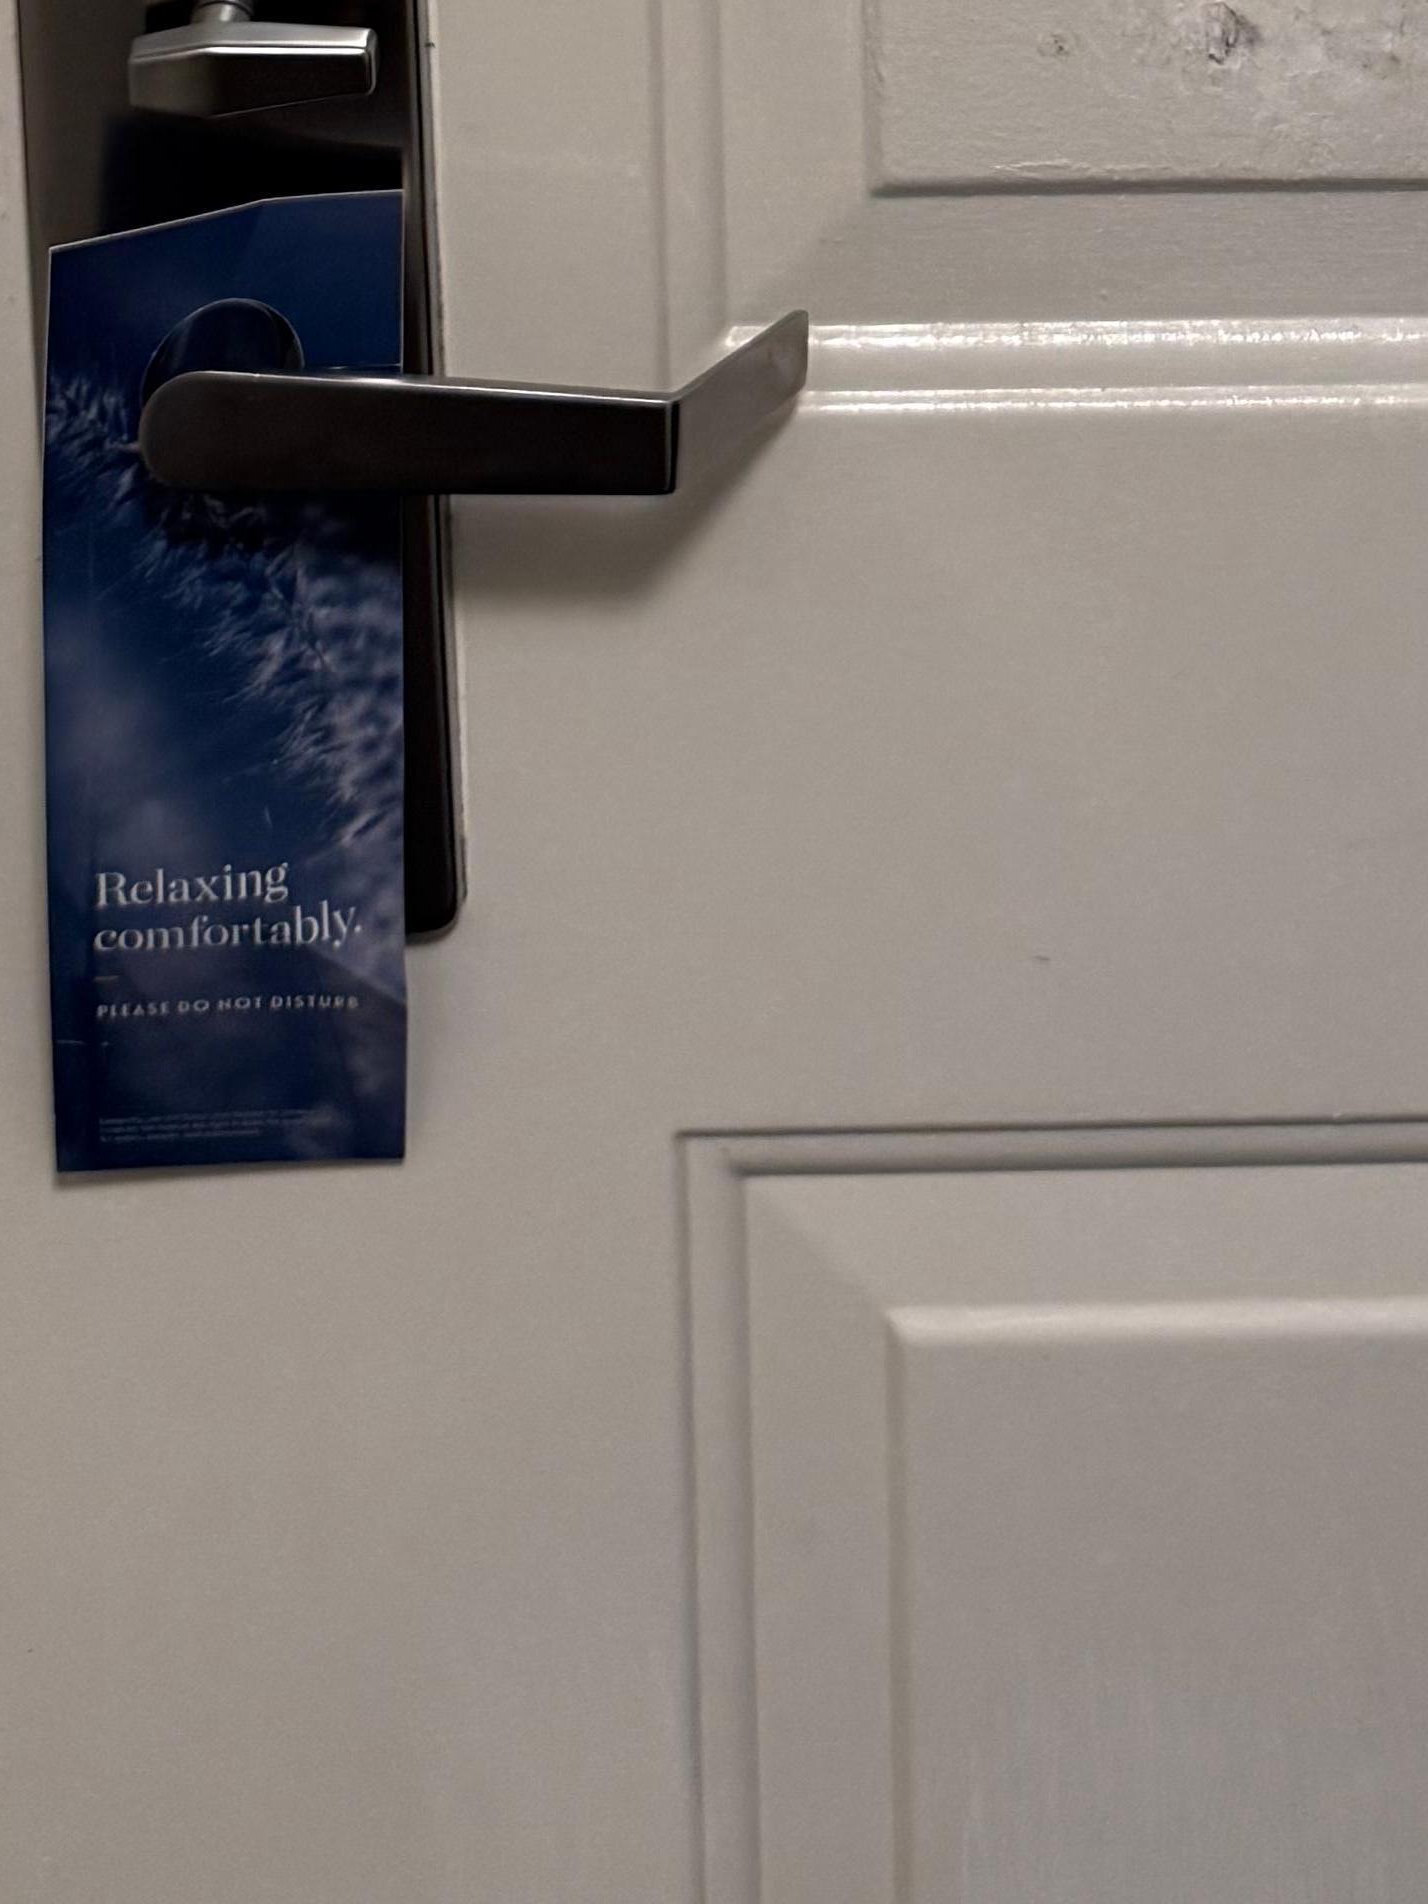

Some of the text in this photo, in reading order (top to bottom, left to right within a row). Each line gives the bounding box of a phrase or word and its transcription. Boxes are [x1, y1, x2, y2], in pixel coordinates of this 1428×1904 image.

[95, 861, 289, 907] Relaxing
[93, 899, 363, 950] comfortably.
[97, 994, 361, 1019] PLEASE DO NOT DISTURB
